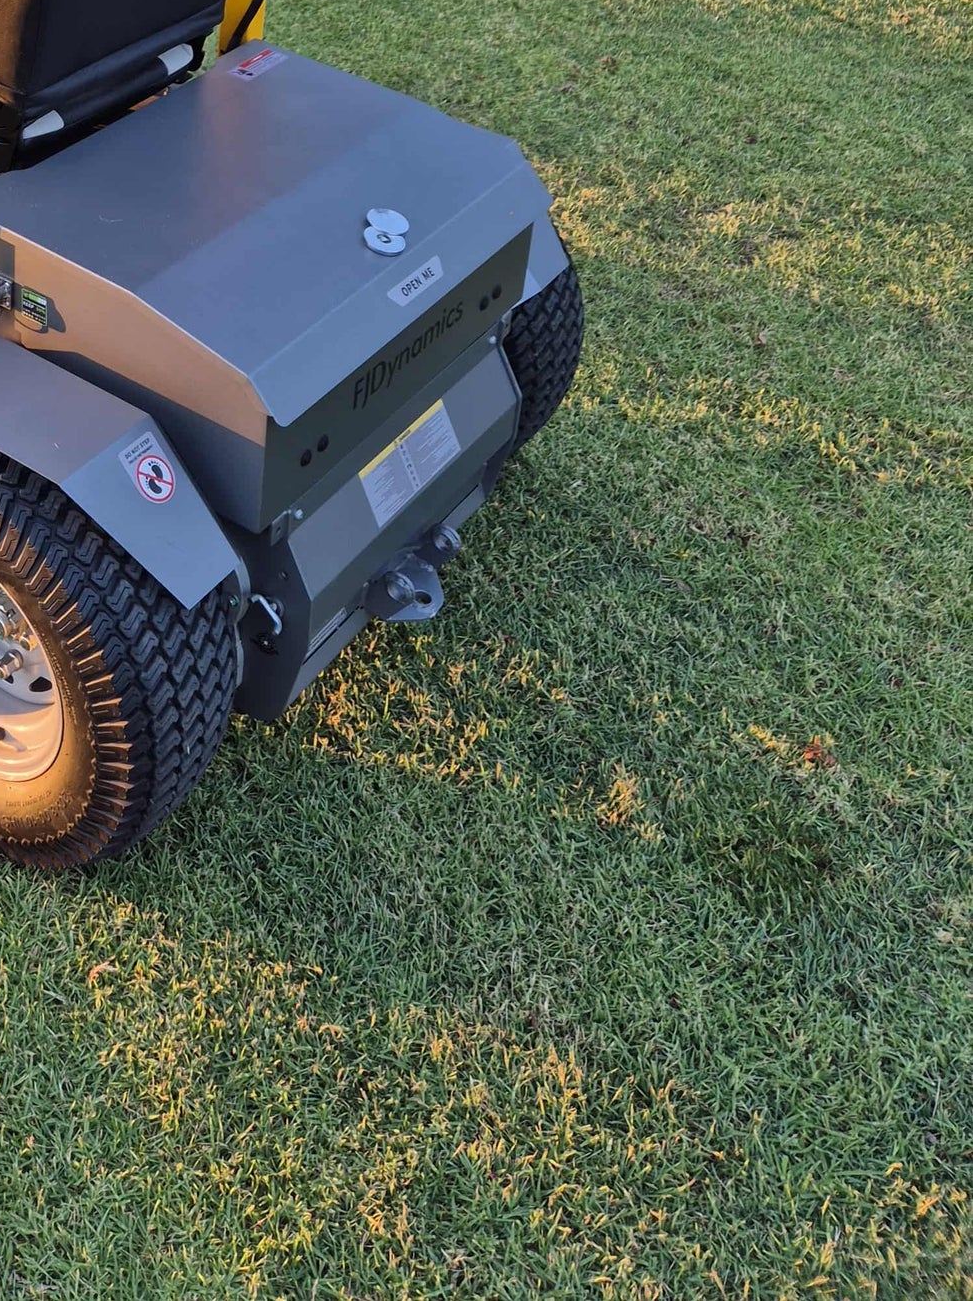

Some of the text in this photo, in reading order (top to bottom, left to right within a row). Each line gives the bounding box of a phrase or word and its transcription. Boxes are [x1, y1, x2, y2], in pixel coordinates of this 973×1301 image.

[401, 267, 435, 297] OPEN ME
[352, 301, 464, 411] FJDynamics
[124, 451, 132, 460] DO
[131, 444, 140, 455] NOT
[139, 437, 150, 449] STEP
